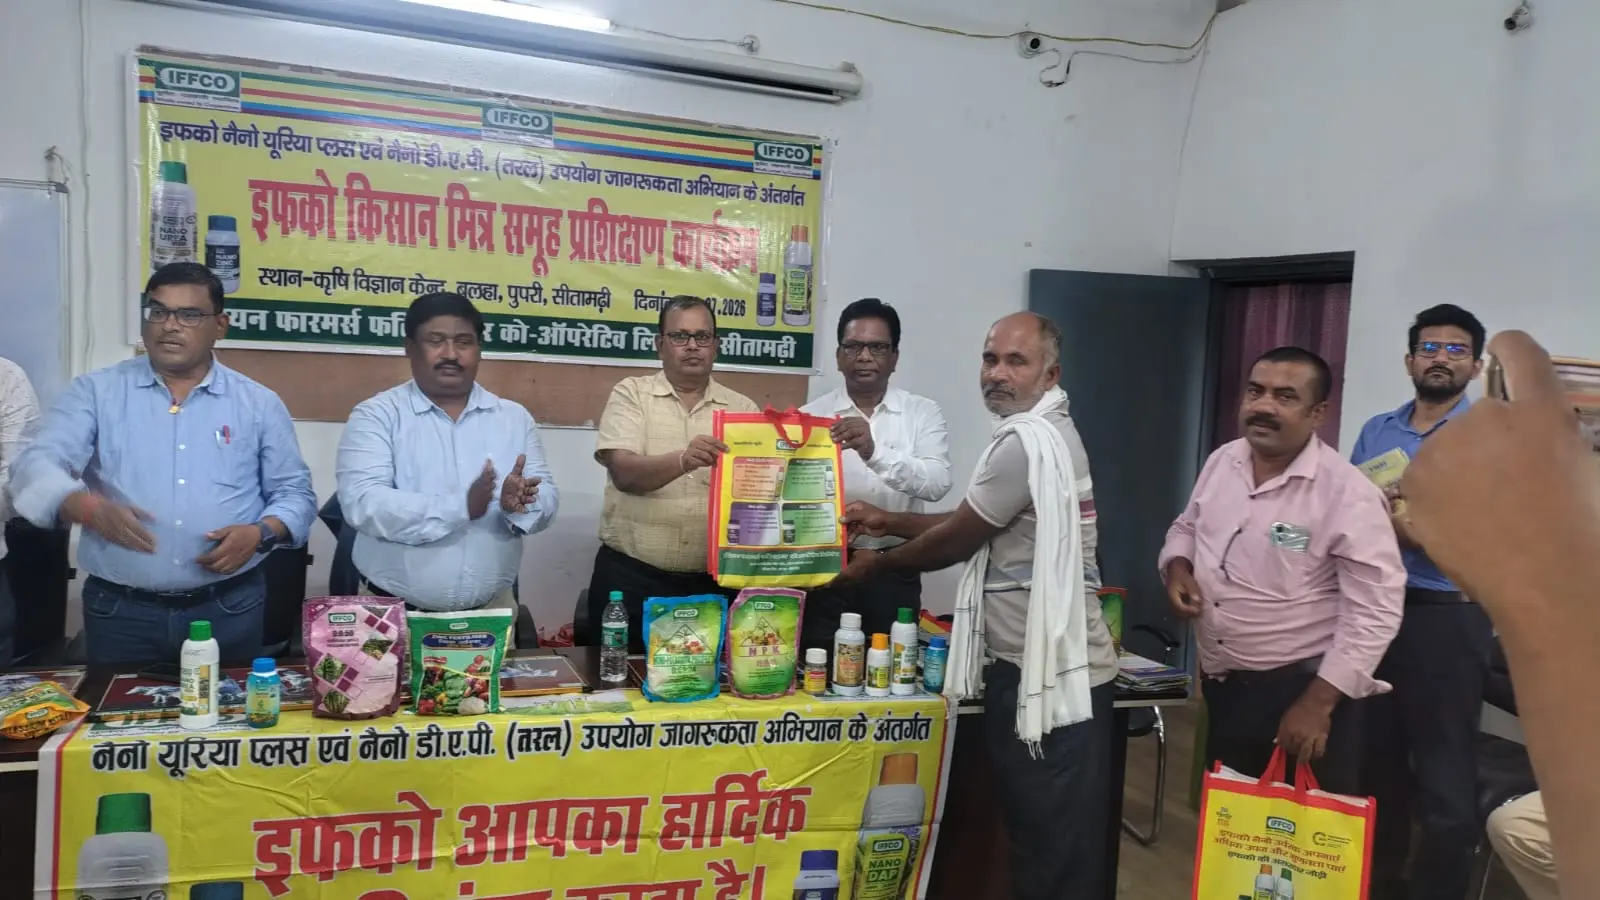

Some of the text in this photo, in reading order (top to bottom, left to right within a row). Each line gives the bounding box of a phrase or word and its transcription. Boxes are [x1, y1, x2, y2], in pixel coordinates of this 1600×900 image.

[168, 69, 229, 91] IFFCO
[493, 110, 543, 129] IFFCO
[160, 119, 218, 144] इफको
[221, 123, 259, 148] नैनो
[263, 126, 313, 159] यूरिया
[316, 136, 356, 158] प्लस
[359, 136, 384, 161] एवं
[386, 138, 421, 164] नैनो
[495, 151, 545, 184] (तरल)
[550, 160, 601, 185] उपयोग
[605, 168, 683, 195] जागरूकता
[685, 174, 741, 201] अभियान
[743, 180, 758, 202] के
[760, 183, 806, 207] अंतर्गत
[763, 146, 805, 161] IFFCO
[248, 168, 338, 243] इफको
[344, 171, 441, 249] किसान
[445, 182, 497, 254] मित्र
[500, 202, 564, 278] समूह
[567, 197, 668, 267] प्रशिक्षण
[257, 266, 349, 296] स्थान-कृषि
[353, 267, 405, 295] विज्ञान
[507, 281, 548, 309] पुपरी,
[551, 284, 612, 314] सीतामढ़ी
[633, 288, 672, 312] दिनां
[274, 307, 363, 336] फारमर्स
[499, 318, 630, 350] को-ऑपरेटिव
[719, 331, 798, 365] सीतामढ़ी
[92, 711, 933, 778] नैनो यूरिया प्लस एवं नैनो डी.ए.पी. (तरल) उपयोग जागरूकता अभियान के अंतर्गत
[252, 769, 814, 898] इफको आपका हार्दिक
[877, 840, 900, 850] IFFCO
[868, 859, 902, 869] NANO
[868, 869, 898, 882] DAP
